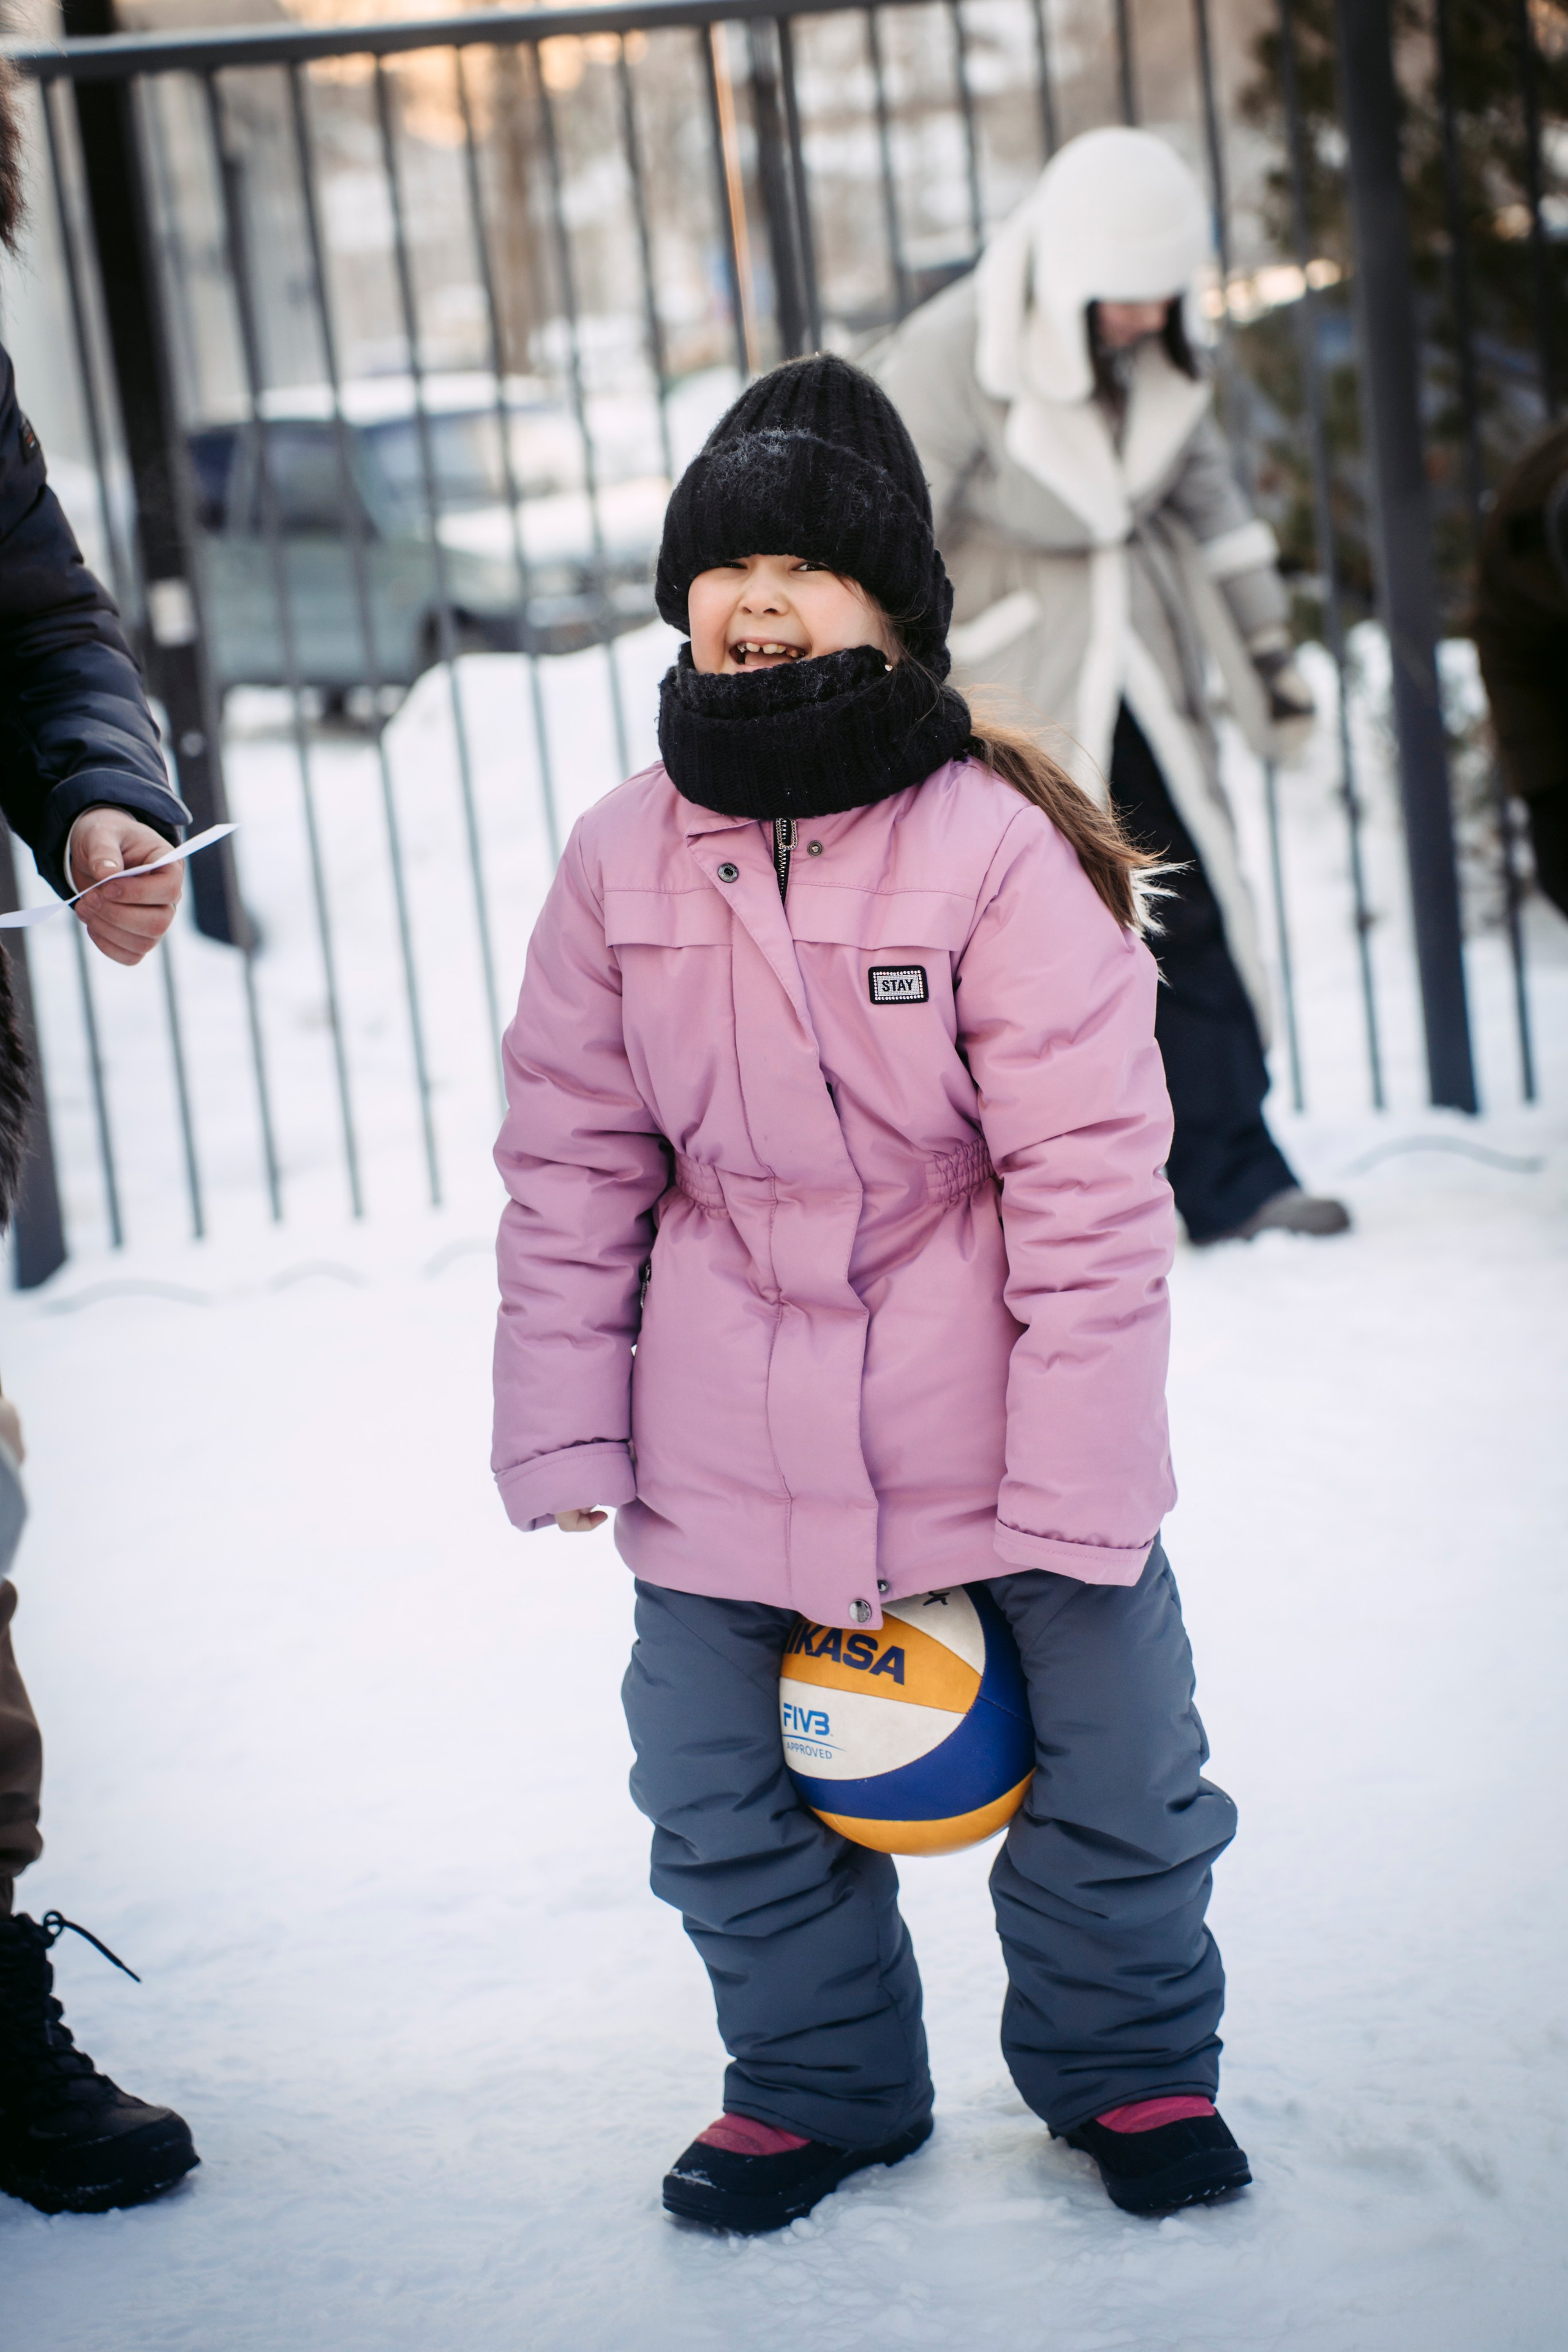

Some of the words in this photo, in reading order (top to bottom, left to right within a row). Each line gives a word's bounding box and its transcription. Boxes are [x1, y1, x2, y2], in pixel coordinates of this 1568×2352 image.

[881, 979, 913, 992] STAY
[785, 1623, 905, 1686] IKASA
[783, 1703, 831, 1736] FIVB
[786, 1741, 832, 1760] APPROVED
